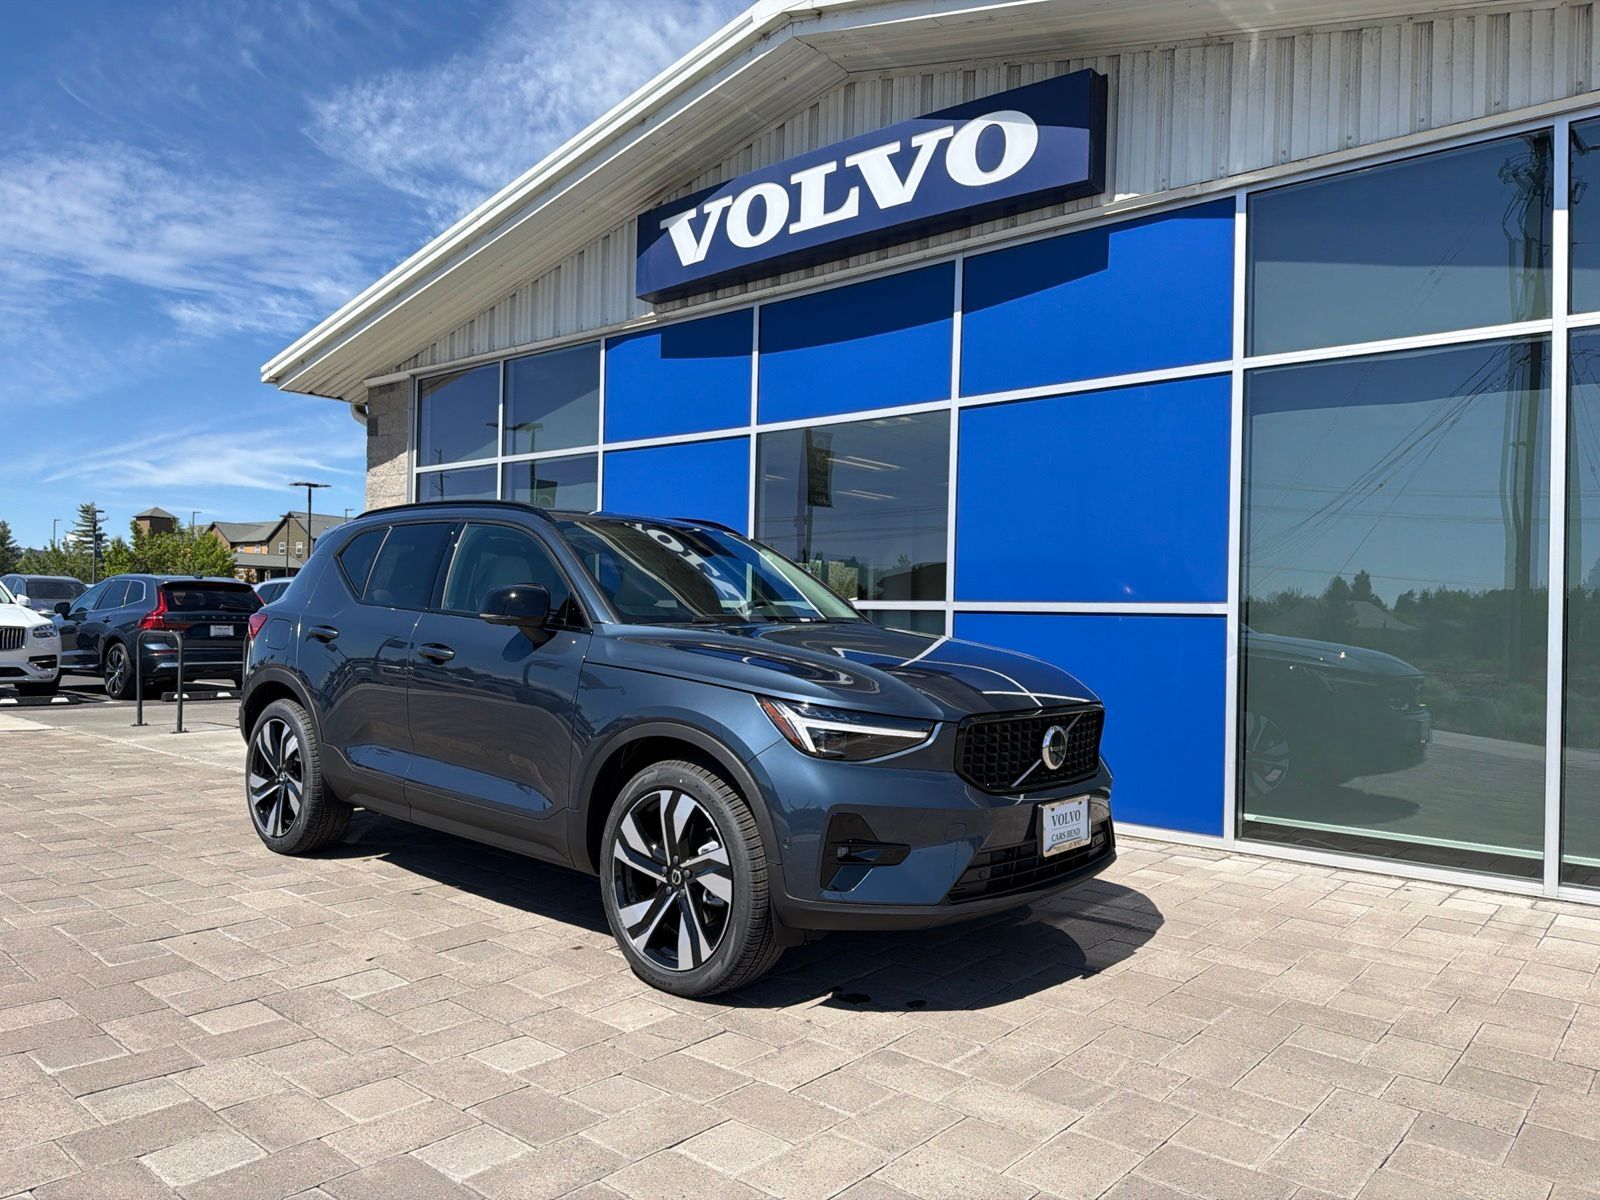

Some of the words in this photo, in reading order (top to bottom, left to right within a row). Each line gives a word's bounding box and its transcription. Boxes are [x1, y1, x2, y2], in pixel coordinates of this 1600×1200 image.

[660, 110, 1038, 266] VOLVO
[1051, 809, 1081, 827] VOLVO
[1051, 832, 1066, 842] CARS
